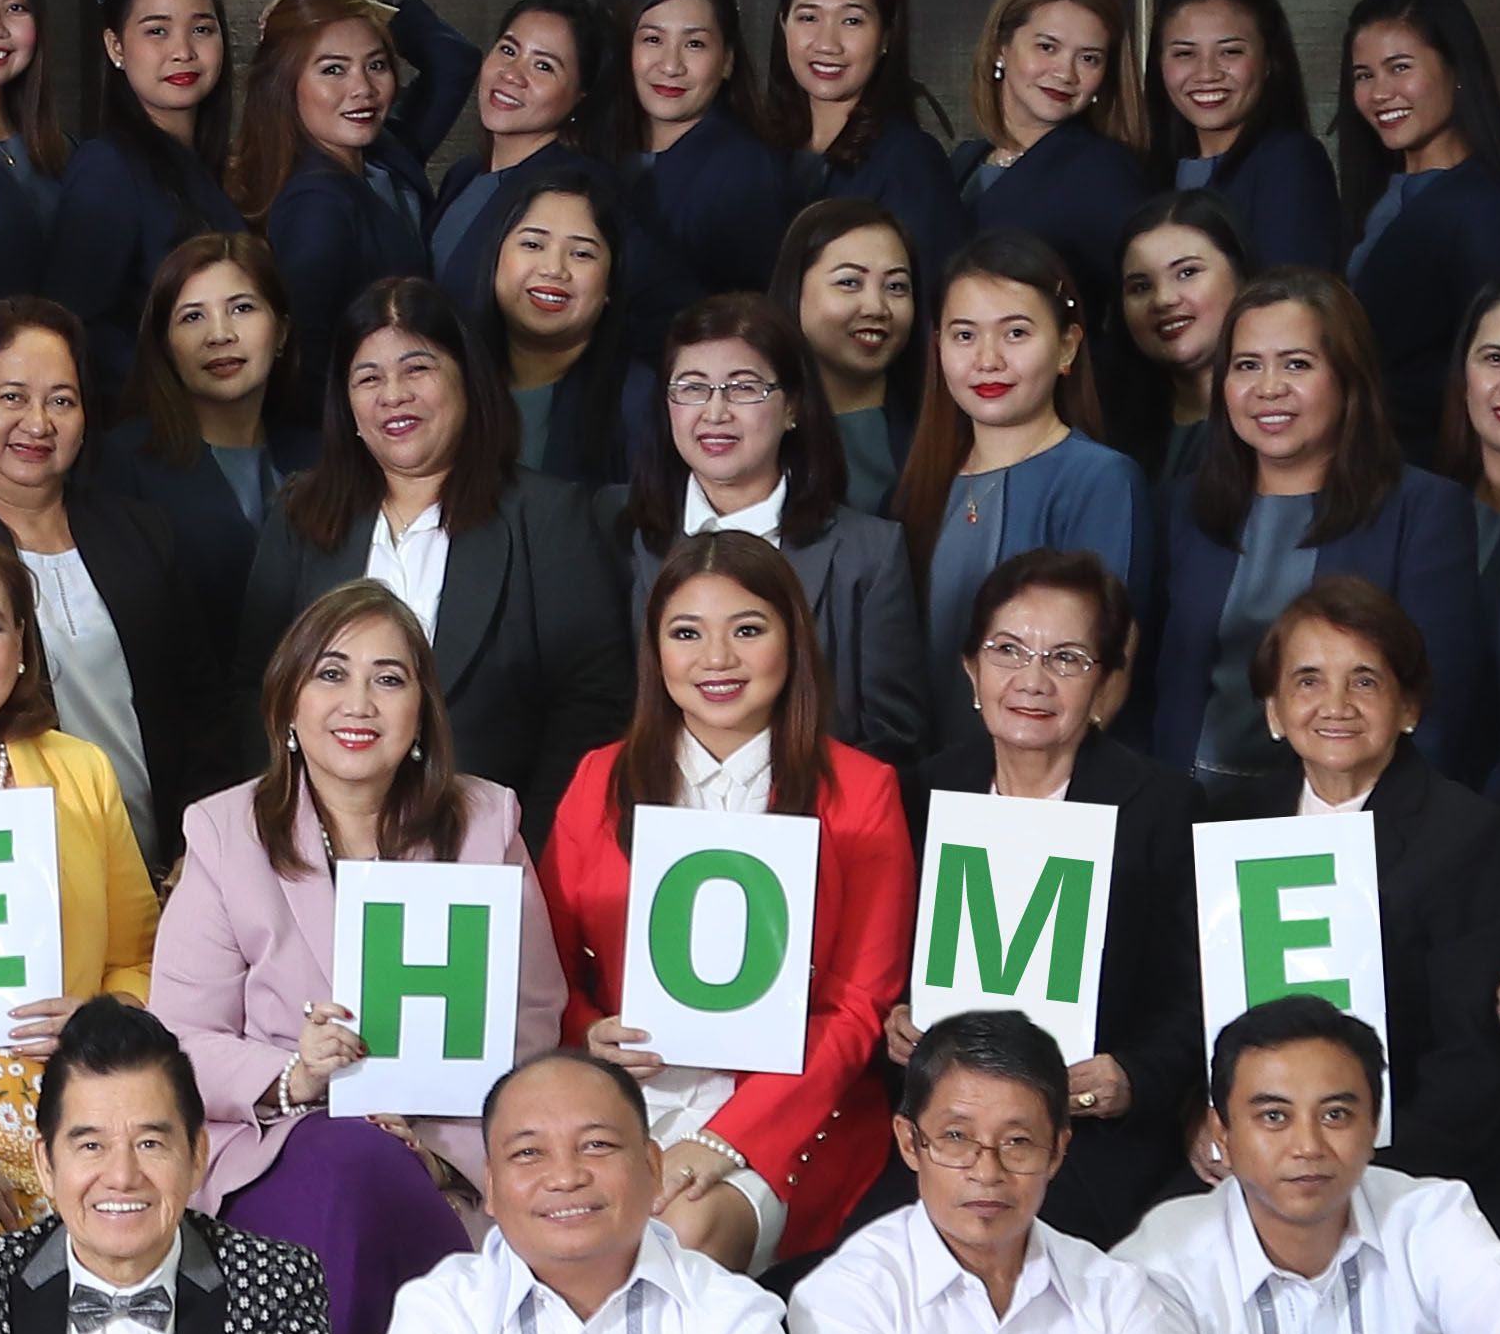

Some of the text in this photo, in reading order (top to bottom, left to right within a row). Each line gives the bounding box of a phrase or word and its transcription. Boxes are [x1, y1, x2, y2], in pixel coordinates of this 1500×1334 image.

[361, 902, 489, 1059] H
[650, 849, 788, 1011] O
[925, 842, 1095, 1004] M
[1235, 853, 1351, 1010] E
